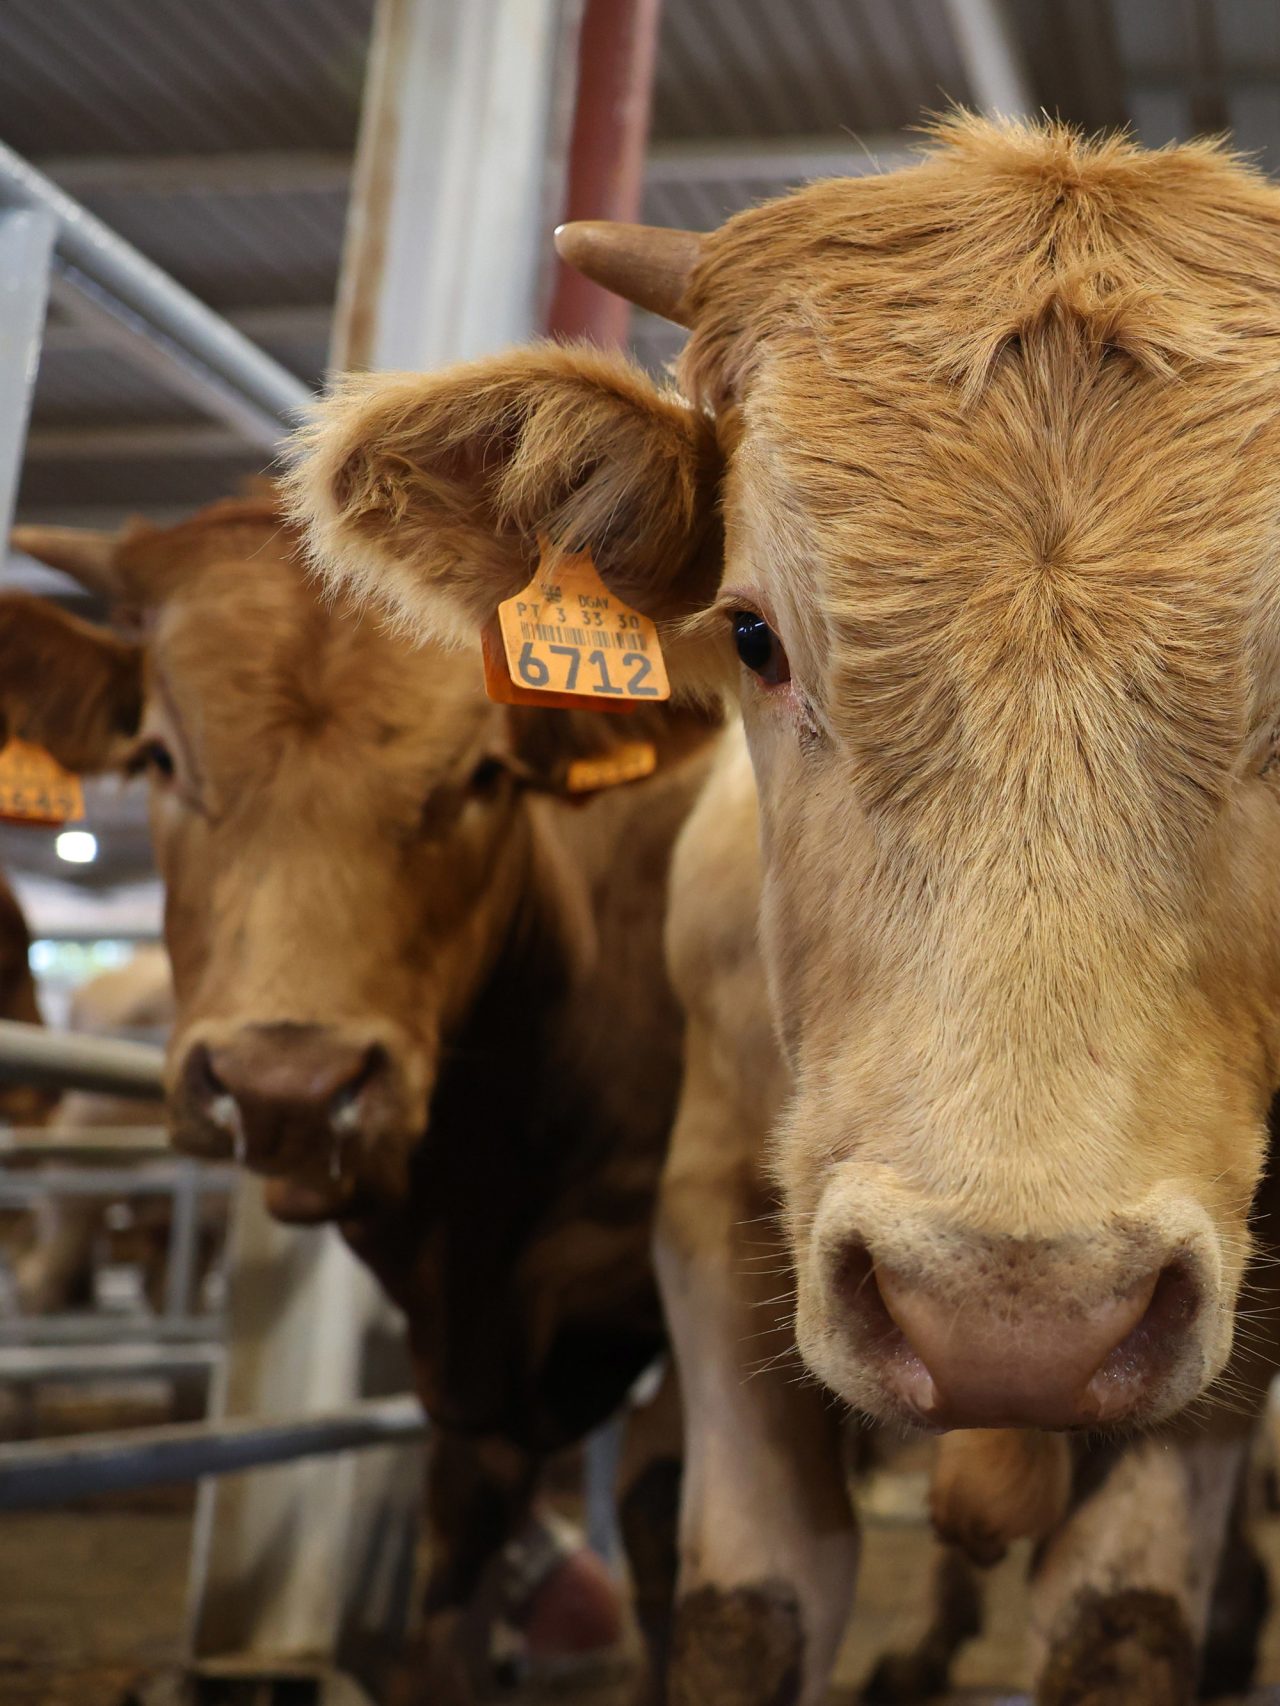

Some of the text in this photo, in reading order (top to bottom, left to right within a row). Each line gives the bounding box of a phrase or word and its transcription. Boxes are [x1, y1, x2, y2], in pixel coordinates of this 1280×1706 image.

[557, 609, 566, 622] 3
[582, 611, 603, 625] 33
[619, 615, 640, 629] 30
[518, 642, 658, 695] 6712
